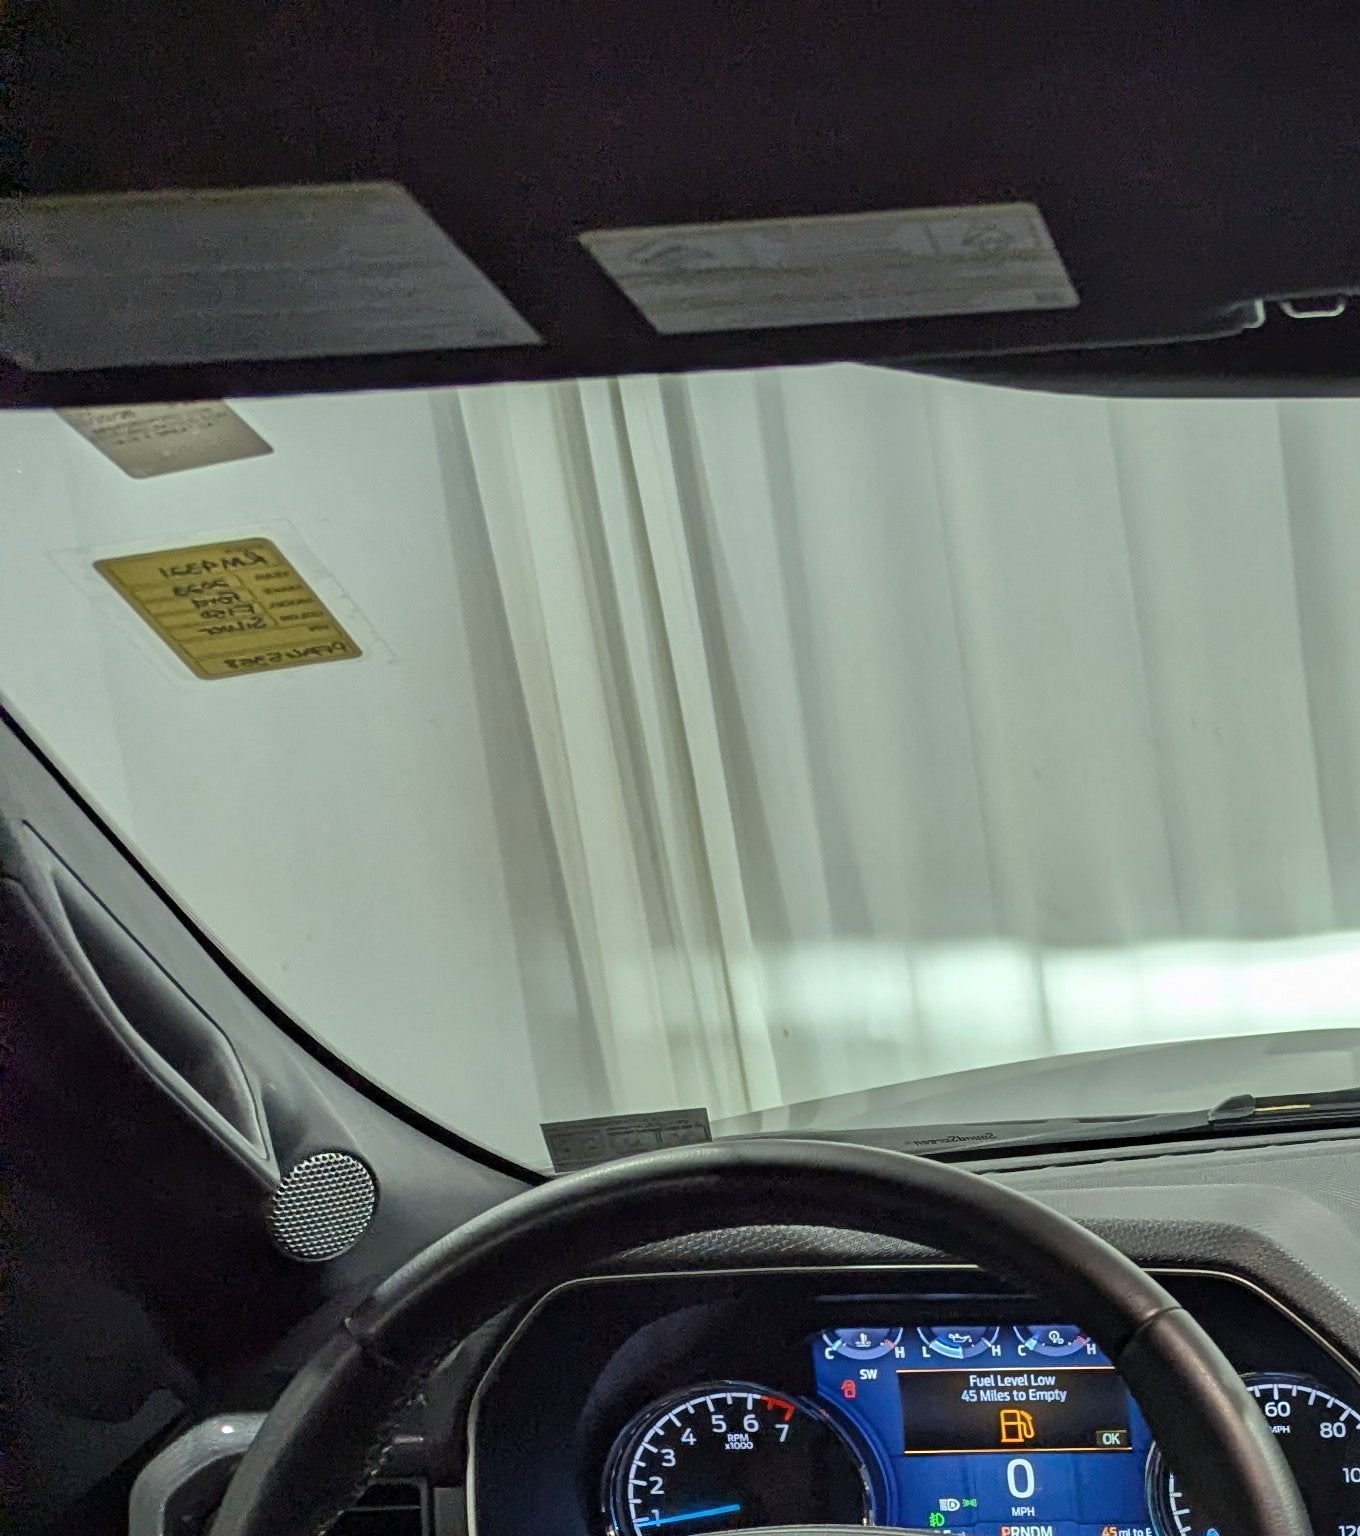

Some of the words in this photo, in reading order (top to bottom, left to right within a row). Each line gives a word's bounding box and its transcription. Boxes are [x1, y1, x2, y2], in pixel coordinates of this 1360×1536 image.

[825, 1348, 834, 1360] C
[895, 1346, 906, 1358] H
[922, 1345, 931, 1357] L
[992, 1345, 1001, 1357] H
[1017, 1345, 1026, 1356] C
[1086, 1344, 1096, 1355] H
[860, 1368, 878, 1380] SW
[969, 1375, 996, 1388] Fuel
[998, 1375, 1029, 1387] Level
[1031, 1374, 1056, 1386] Low
[961, 1390, 978, 1403] 45
[980, 1390, 1010, 1402] Miles
[1012, 1390, 1026, 1401] to
[1028, 1389, 1067, 1403] Empty
[1264, 1401, 1291, 1418] 60
[711, 1414, 727, 1433] 5
[743, 1414, 759, 1432] 6
[681, 1428, 697, 1446] 4
[727, 1433, 749, 1442] RPM
[775, 1424, 790, 1442] 7
[1319, 1422, 1346, 1439] 80
[1102, 1432, 1120, 1445] OK
[661, 1449, 677, 1467] 3
[1006, 1458, 1035, 1498] 0
[650, 1476, 665, 1495] 2
[1011, 1506, 1035, 1517] MPH
